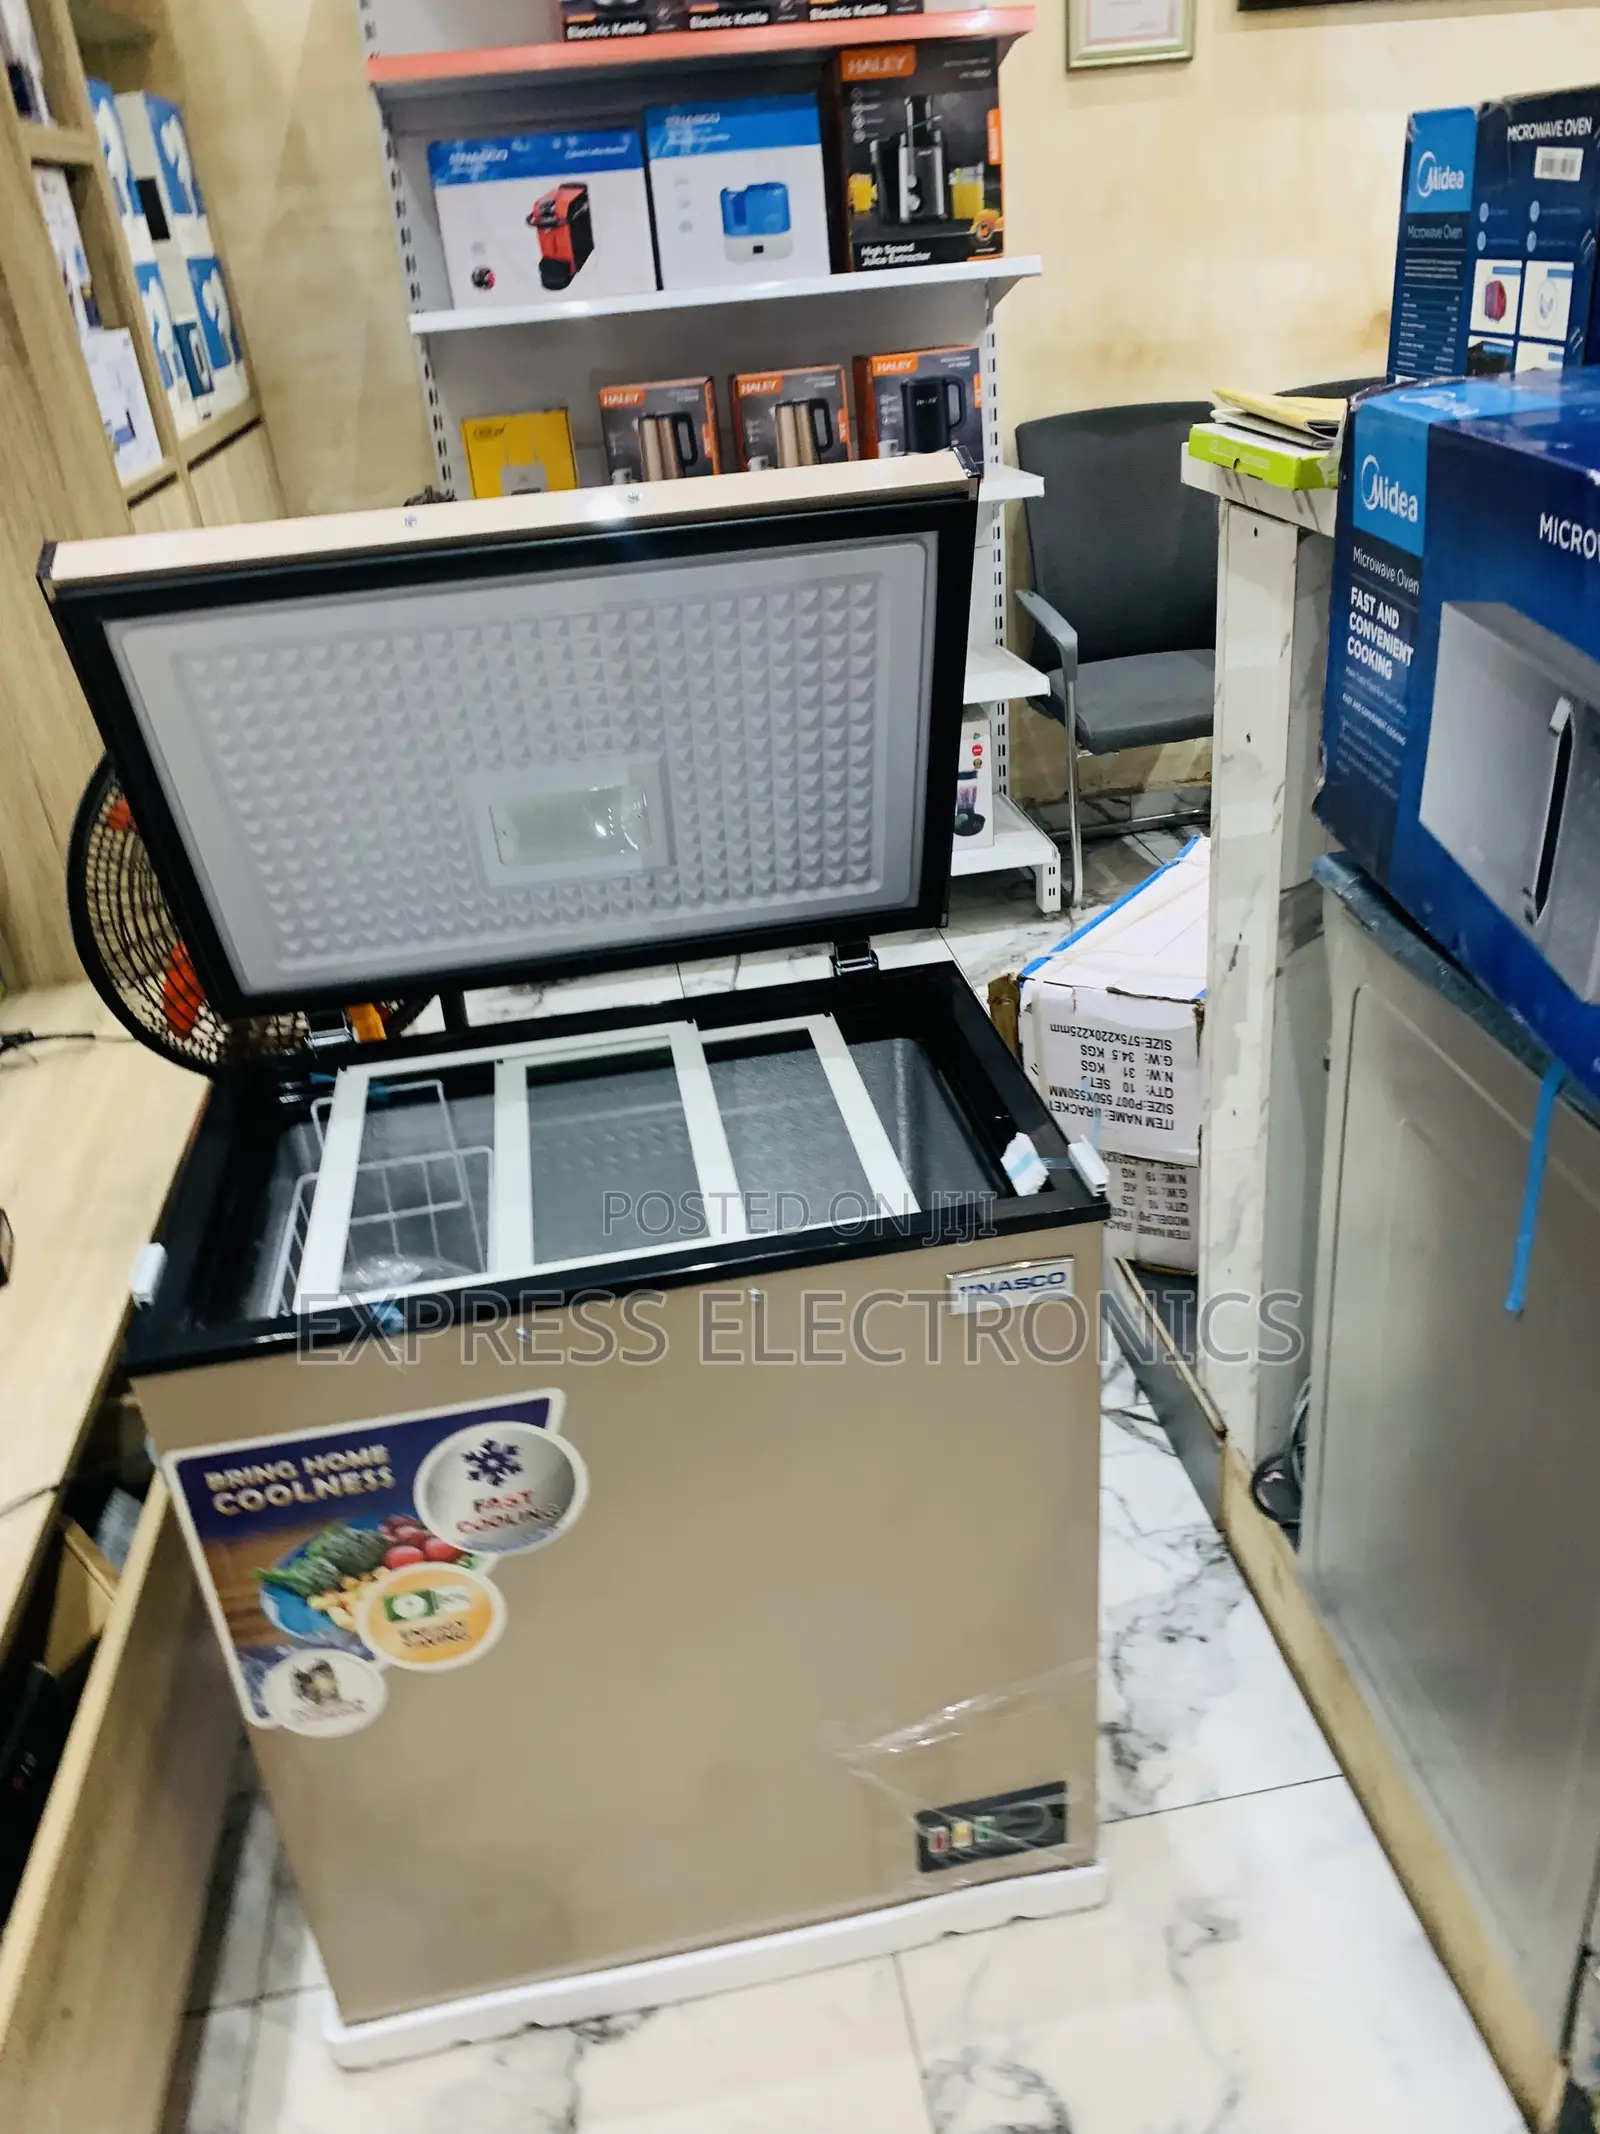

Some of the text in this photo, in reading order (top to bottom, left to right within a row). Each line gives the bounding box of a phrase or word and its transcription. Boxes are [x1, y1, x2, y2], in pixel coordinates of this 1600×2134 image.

[848, 55, 907, 75] HALEY
[1507, 116, 1593, 142] MICROWAVE OVEN
[1417, 150, 1465, 198] Midea
[1407, 223, 1463, 240] Microwave Oven
[876, 359, 913, 373] HALEY
[603, 392, 640, 406] HALEY
[740, 379, 778, 394] HALEY
[1361, 454, 1418, 523] Midea
[1539, 511, 1600, 564] MICRO
[1353, 546, 1420, 597] Microwave Oven
[1350, 586, 1400, 630] FAST AND
[1349, 611, 1414, 667] CONVENIENT
[1347, 635, 1393, 680] COOKING
[1050, 1024, 1172, 1051] SIZE:575x220x225mm
[1080, 1044, 1173, 1067] G.W: 34.5 KGS
[1081, 1060, 1174, 1083] N.W: 31 KGS
[1048, 1085, 1174, 1115] SIZE:P007 550X550MM
[1122, 1082, 1136, 1094] 10
[1145, 1085, 1174, 1099] QTY:
[1104, 1109, 1142, 1126] NAME:
[1145, 1117, 1175, 1131] ITEM
[203, 1443, 391, 1492] BRING HOME
[212, 1465, 396, 1516] COOLNESS
